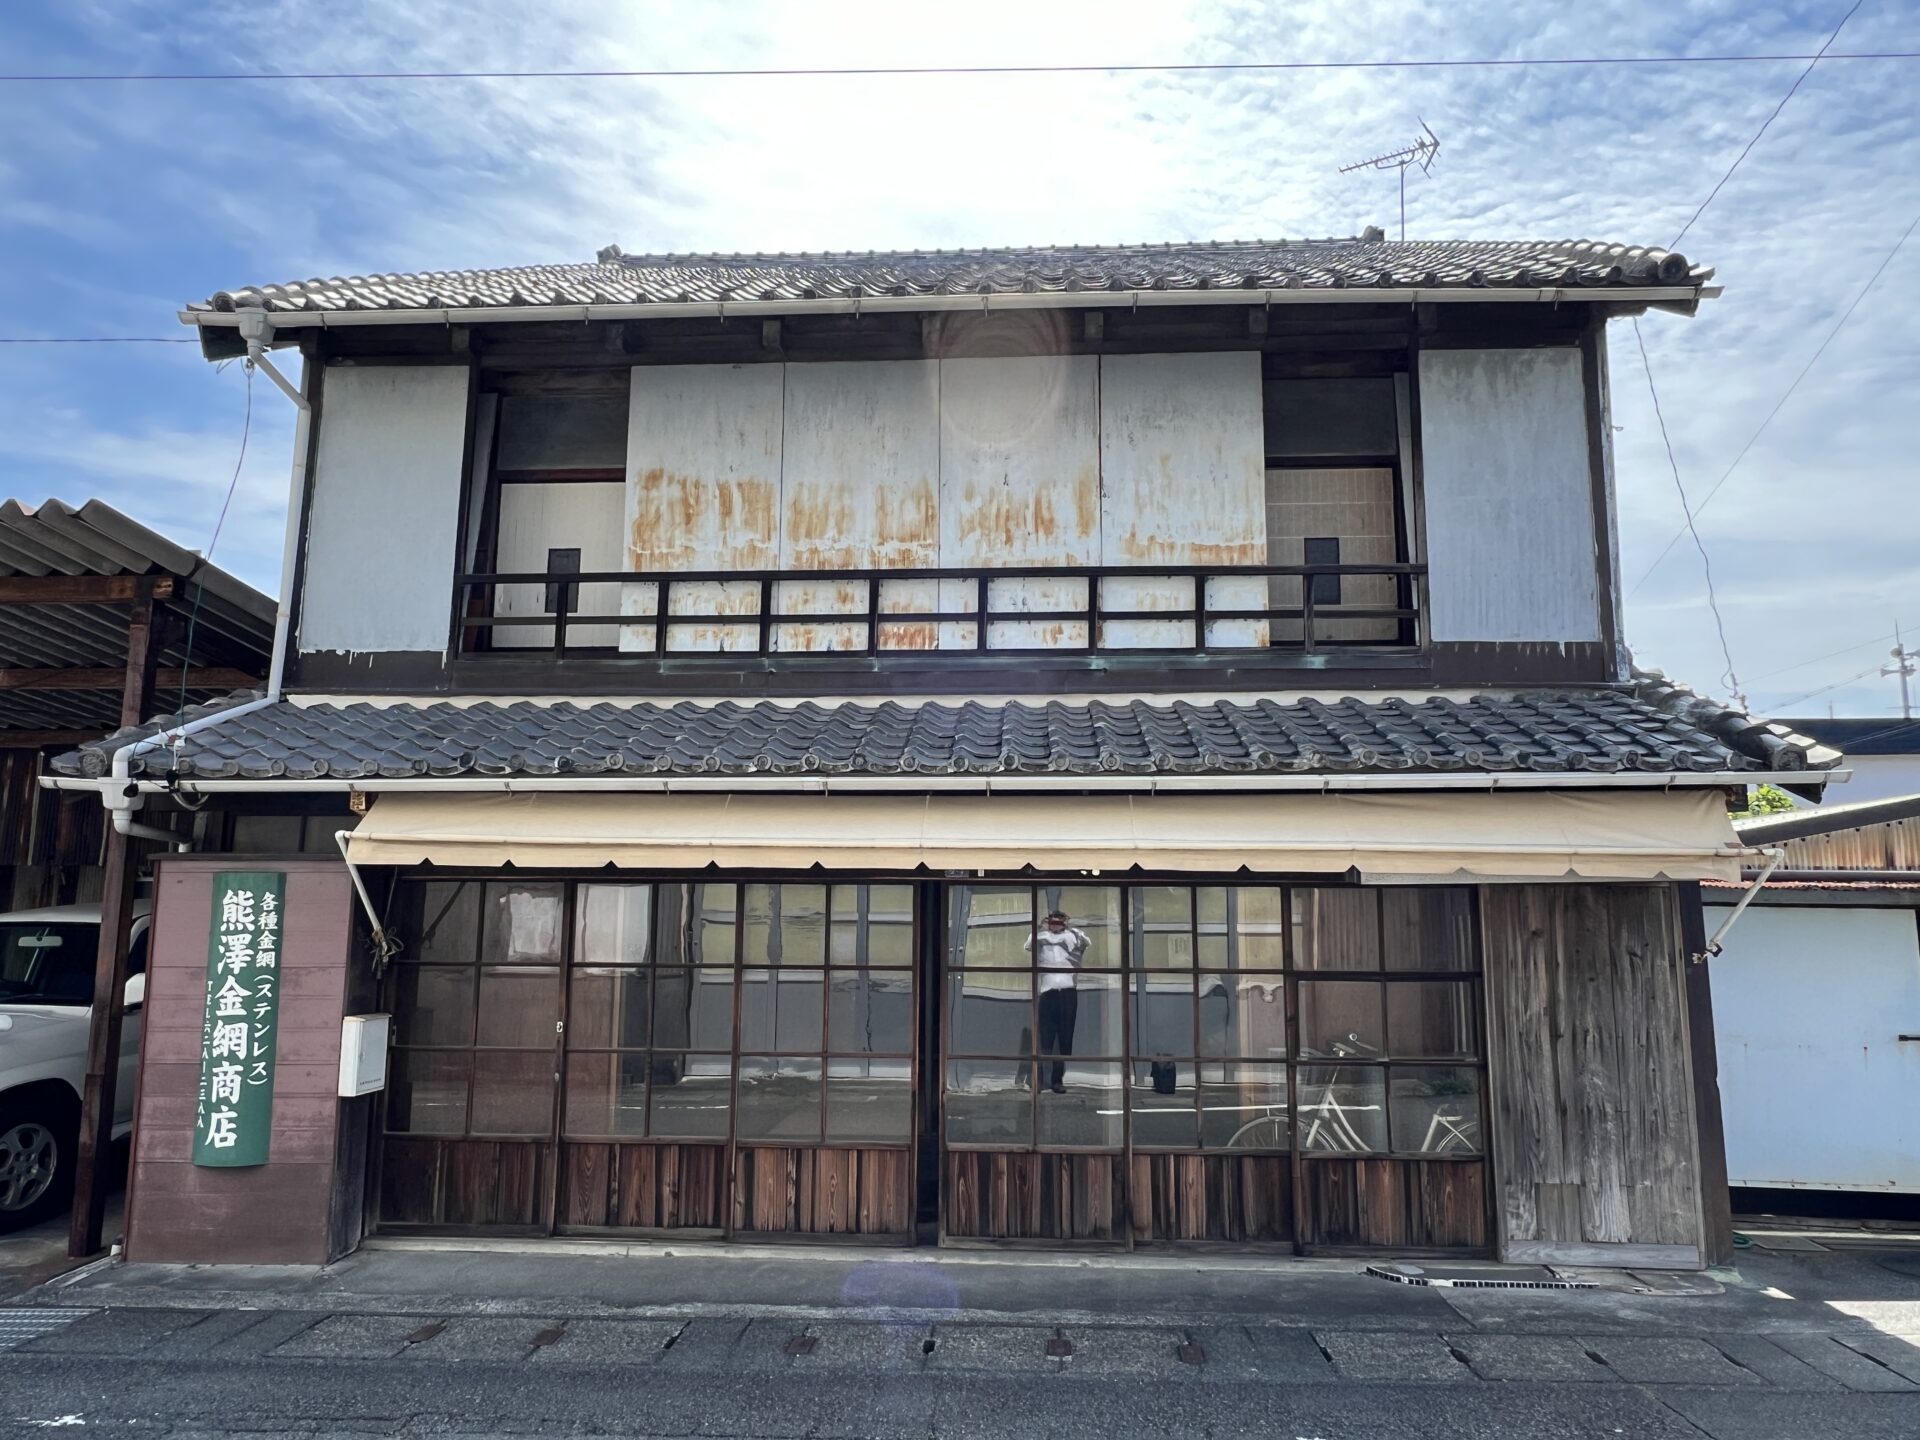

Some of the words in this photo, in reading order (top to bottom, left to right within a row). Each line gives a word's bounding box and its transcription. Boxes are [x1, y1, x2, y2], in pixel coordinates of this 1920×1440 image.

[205, 889, 255, 1149] 熊澤金網商店
